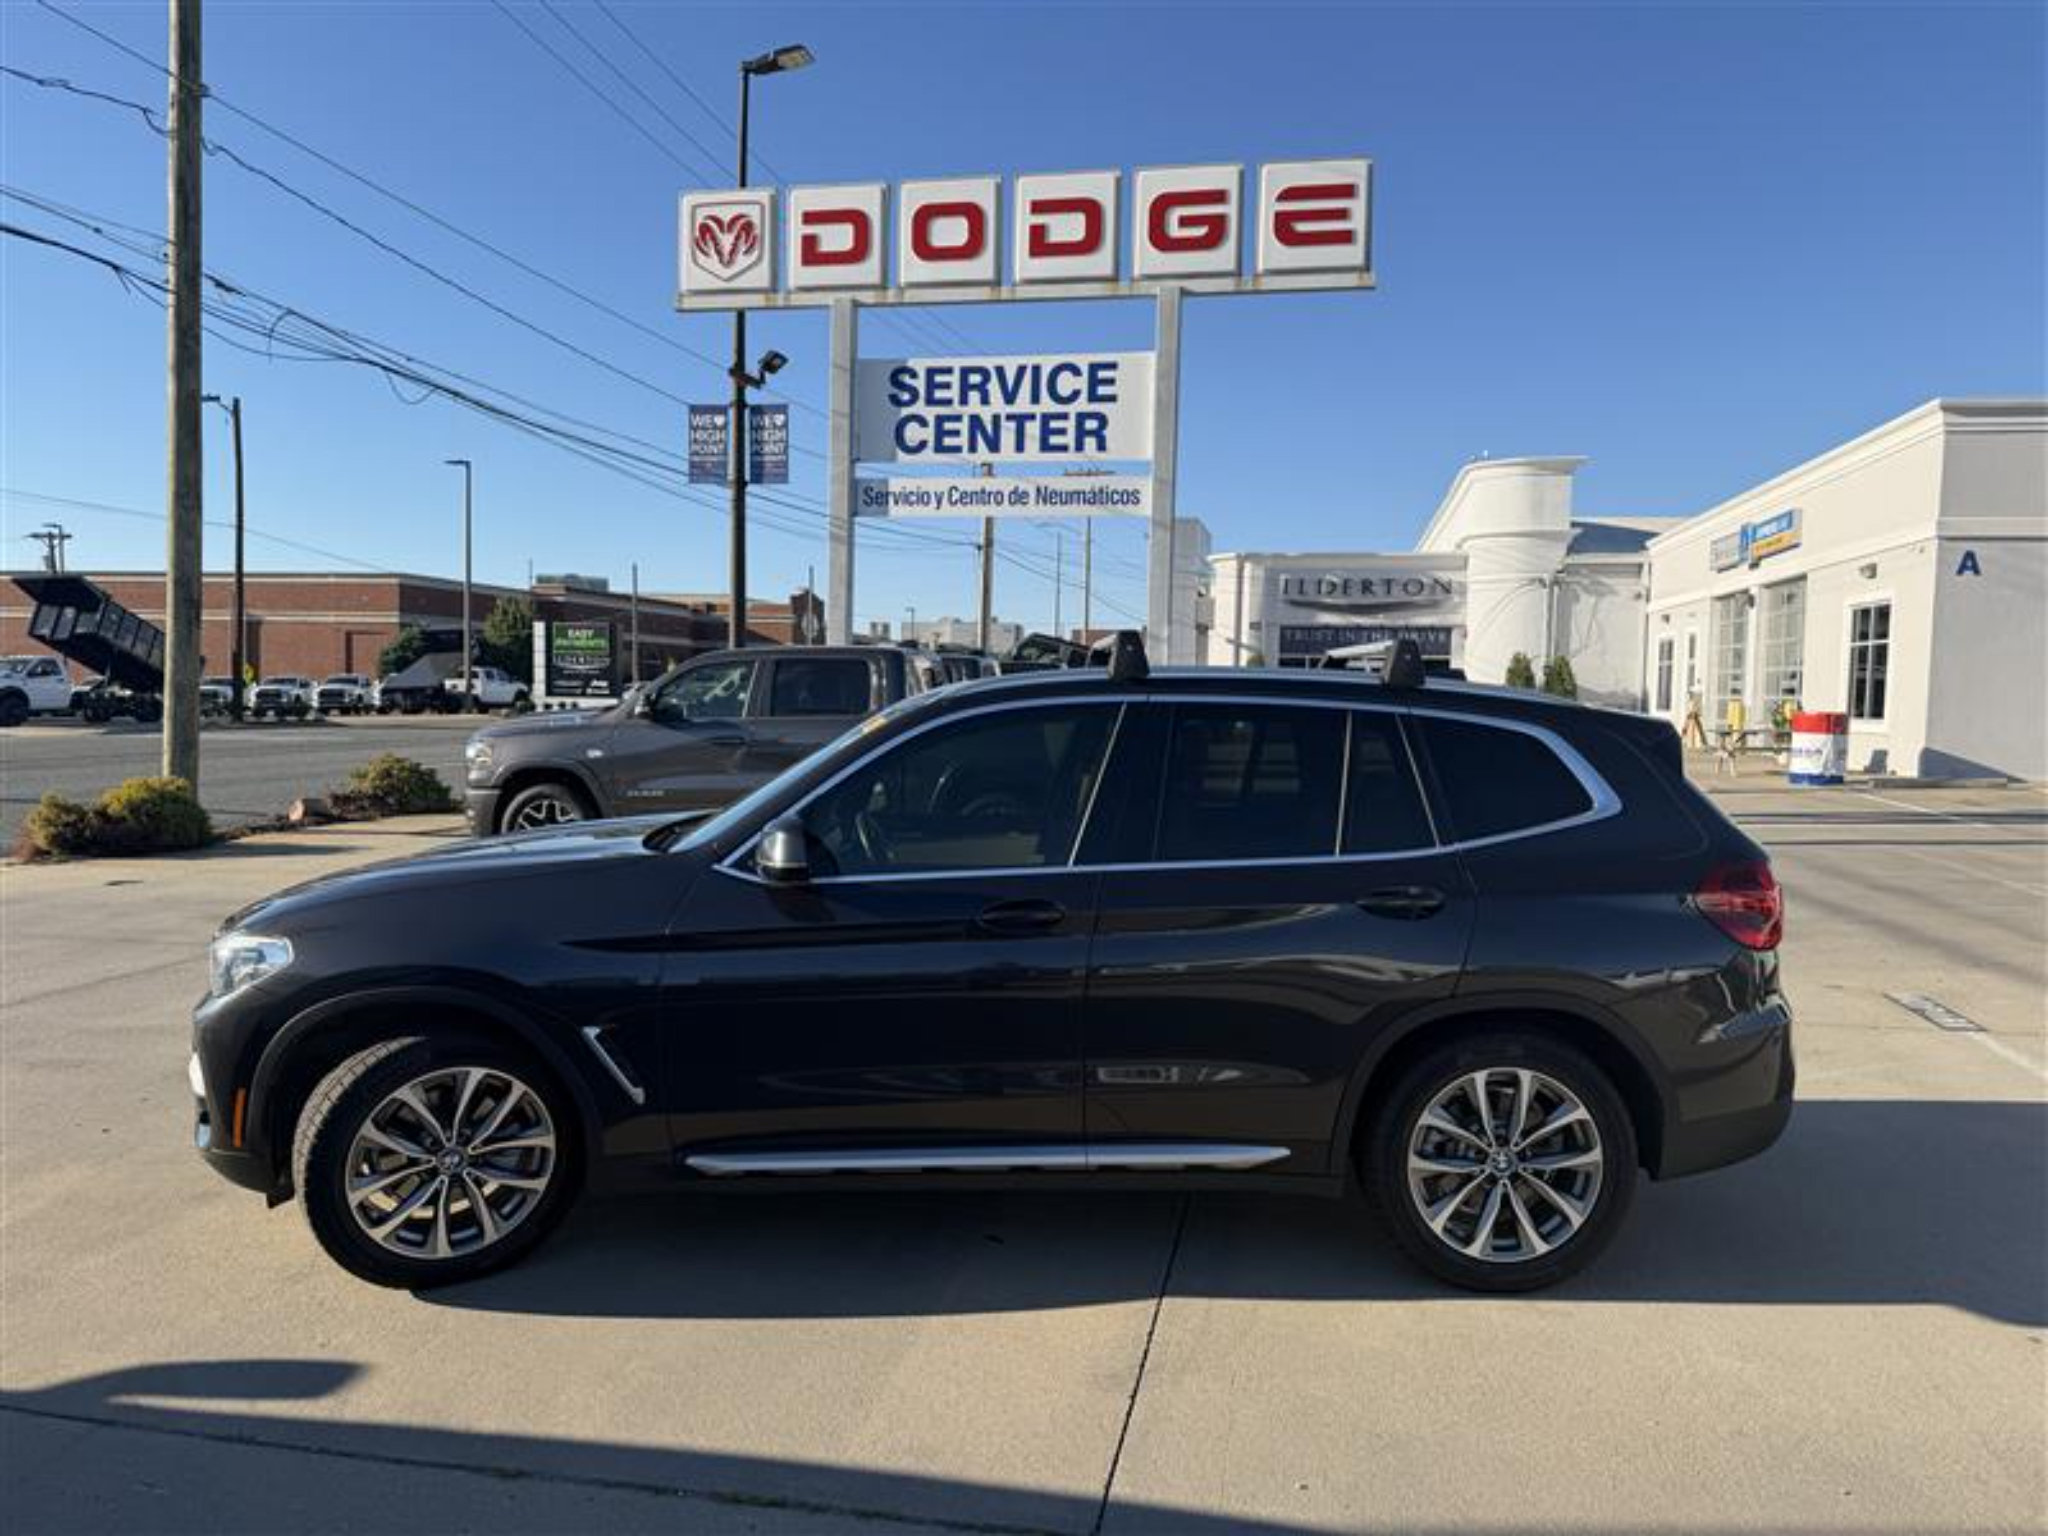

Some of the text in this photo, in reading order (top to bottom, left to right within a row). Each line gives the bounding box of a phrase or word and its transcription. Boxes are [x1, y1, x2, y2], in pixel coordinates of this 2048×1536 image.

[801, 184, 1356, 266] DODGE
[888, 361, 1117, 407] SERVICE
[691, 413, 713, 428] WE
[893, 411, 1109, 454] CENTER
[691, 430, 726, 442] HIGH
[862, 485, 1141, 510] Servicio y Centro de Neumáticos
[1956, 550, 1981, 575] A
[1282, 577, 1453, 596] ILDERTON
